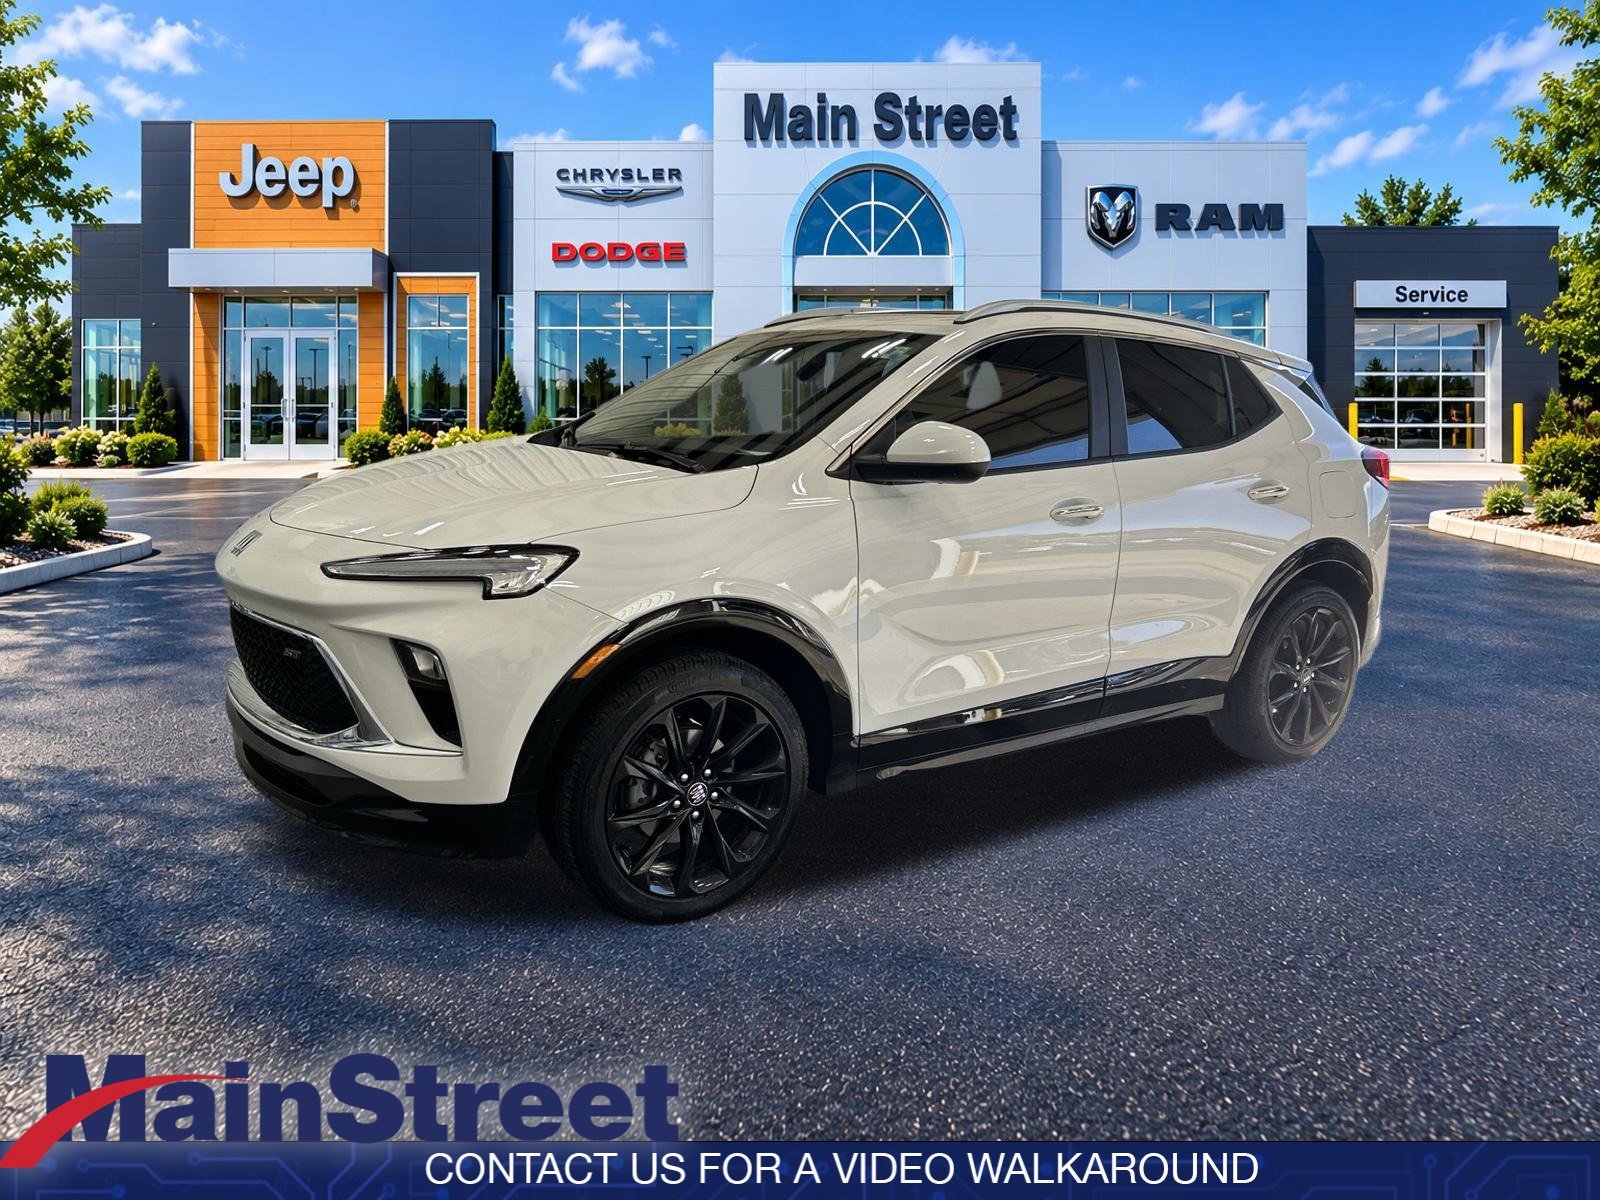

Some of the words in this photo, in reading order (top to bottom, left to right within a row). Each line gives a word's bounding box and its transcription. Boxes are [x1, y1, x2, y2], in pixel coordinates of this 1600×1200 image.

[744, 92, 856, 142] Main
[873, 91, 1018, 142] Street
[218, 143, 356, 208] Jeep
[556, 168, 682, 182] CHRYSLER
[1155, 203, 1284, 232] RAM
[551, 241, 686, 263] DODGE
[1395, 285, 1469, 303] Service
